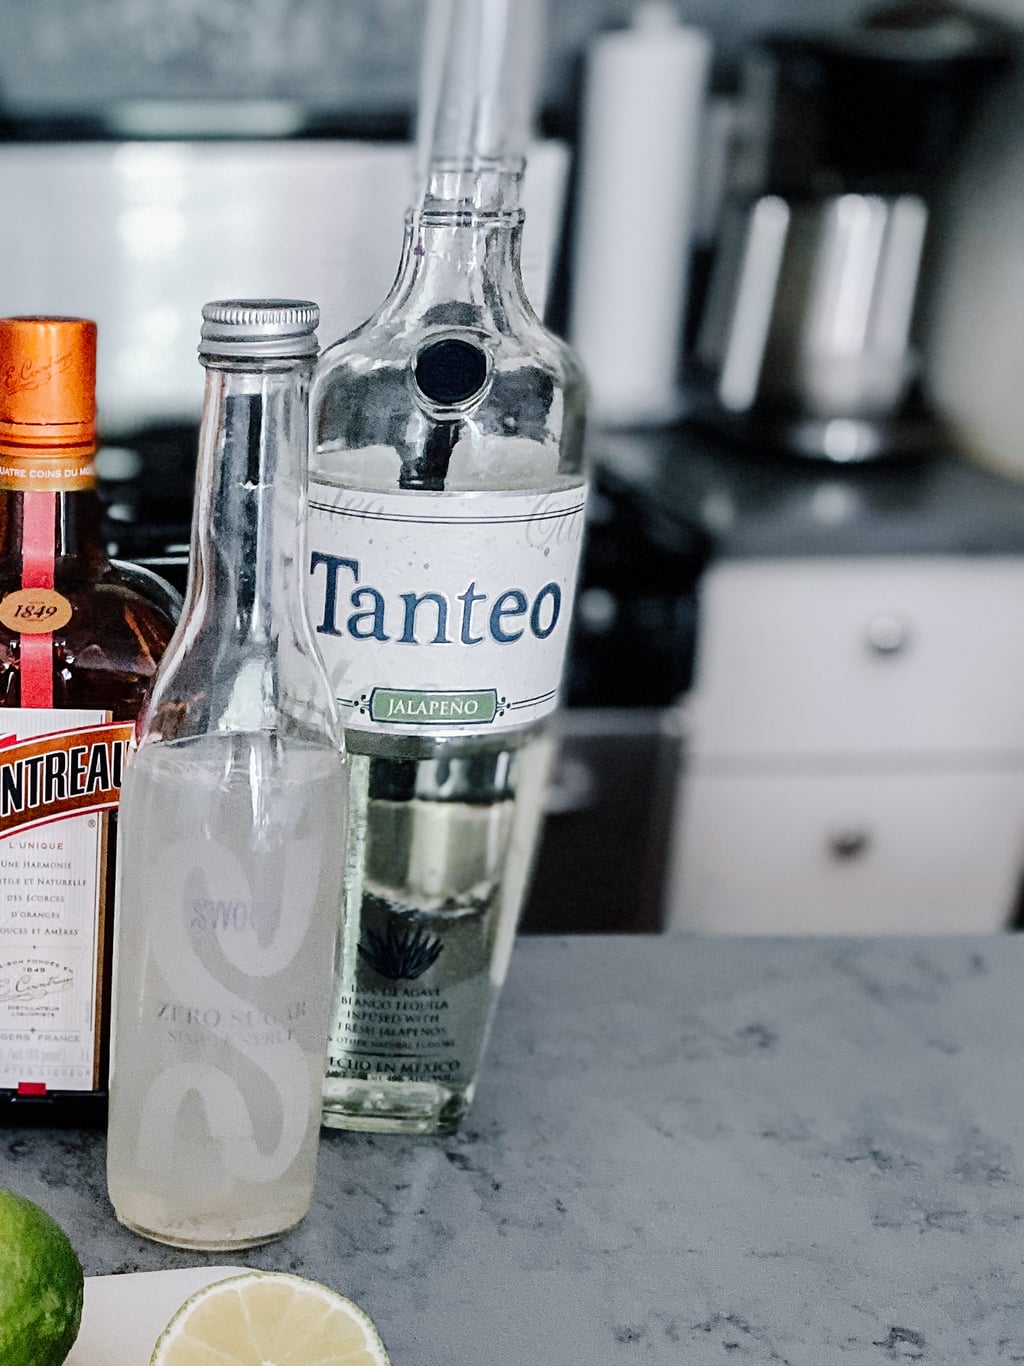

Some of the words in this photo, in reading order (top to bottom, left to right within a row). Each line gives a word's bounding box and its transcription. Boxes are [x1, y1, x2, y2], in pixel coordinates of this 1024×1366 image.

[29, 469, 62, 479] COINS
[64, 468, 78, 478] DU
[309, 551, 562, 645] Tanteo
[13, 604, 58, 619] 1849
[329, 1056, 372, 1072] ECHO
